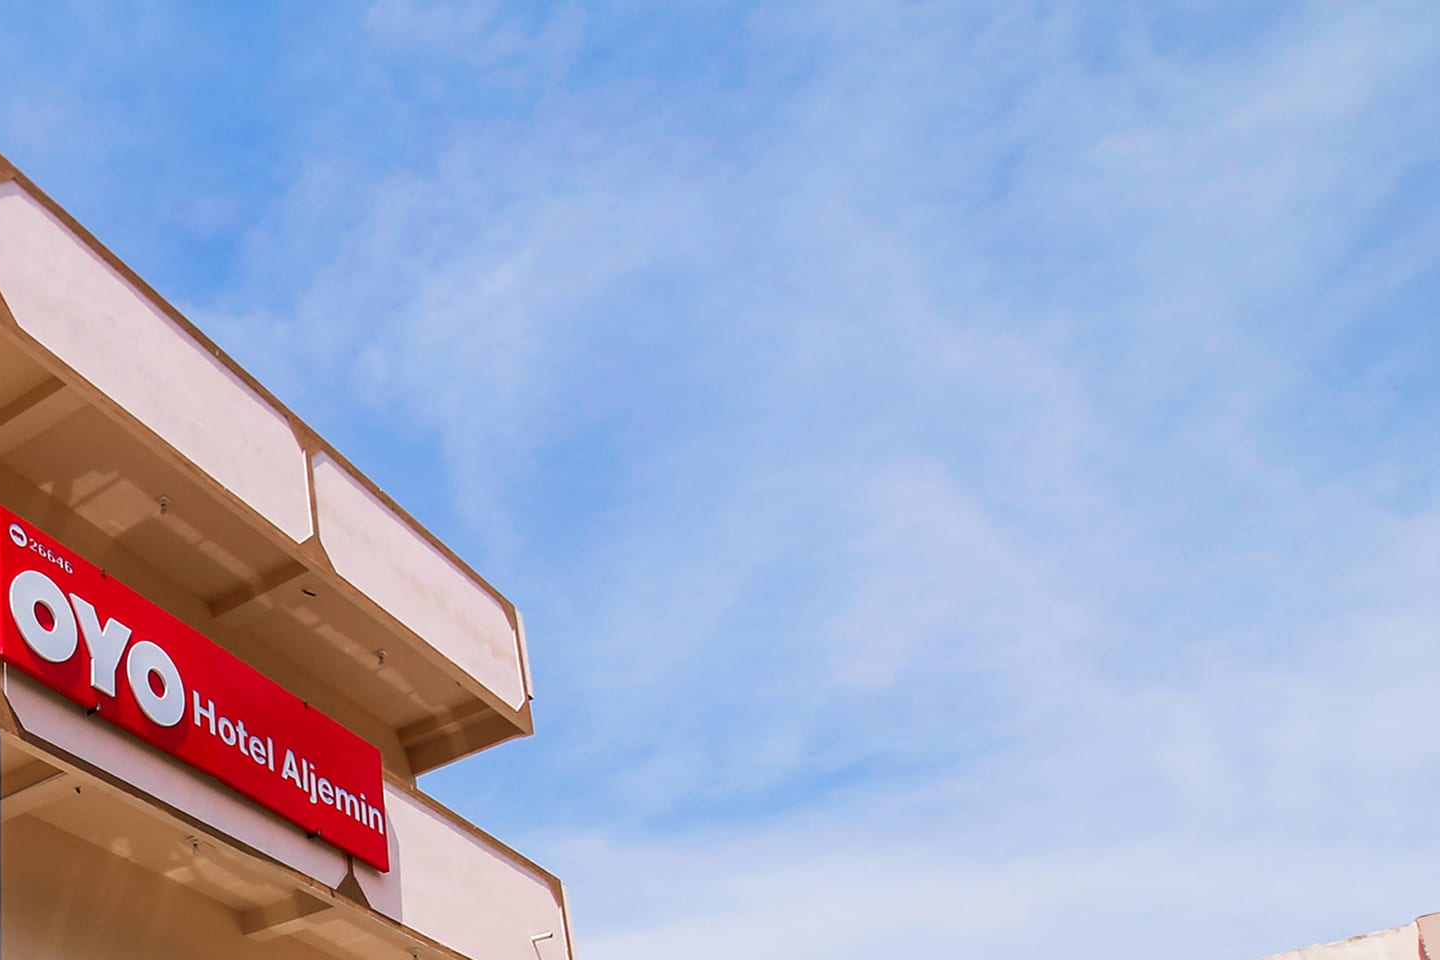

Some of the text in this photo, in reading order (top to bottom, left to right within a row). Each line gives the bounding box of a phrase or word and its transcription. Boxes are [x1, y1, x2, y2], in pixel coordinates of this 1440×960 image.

[29, 538, 73, 574] 26646
[9, 570, 186, 728] OYO
[193, 690, 385, 836] Hotel Aljemin
